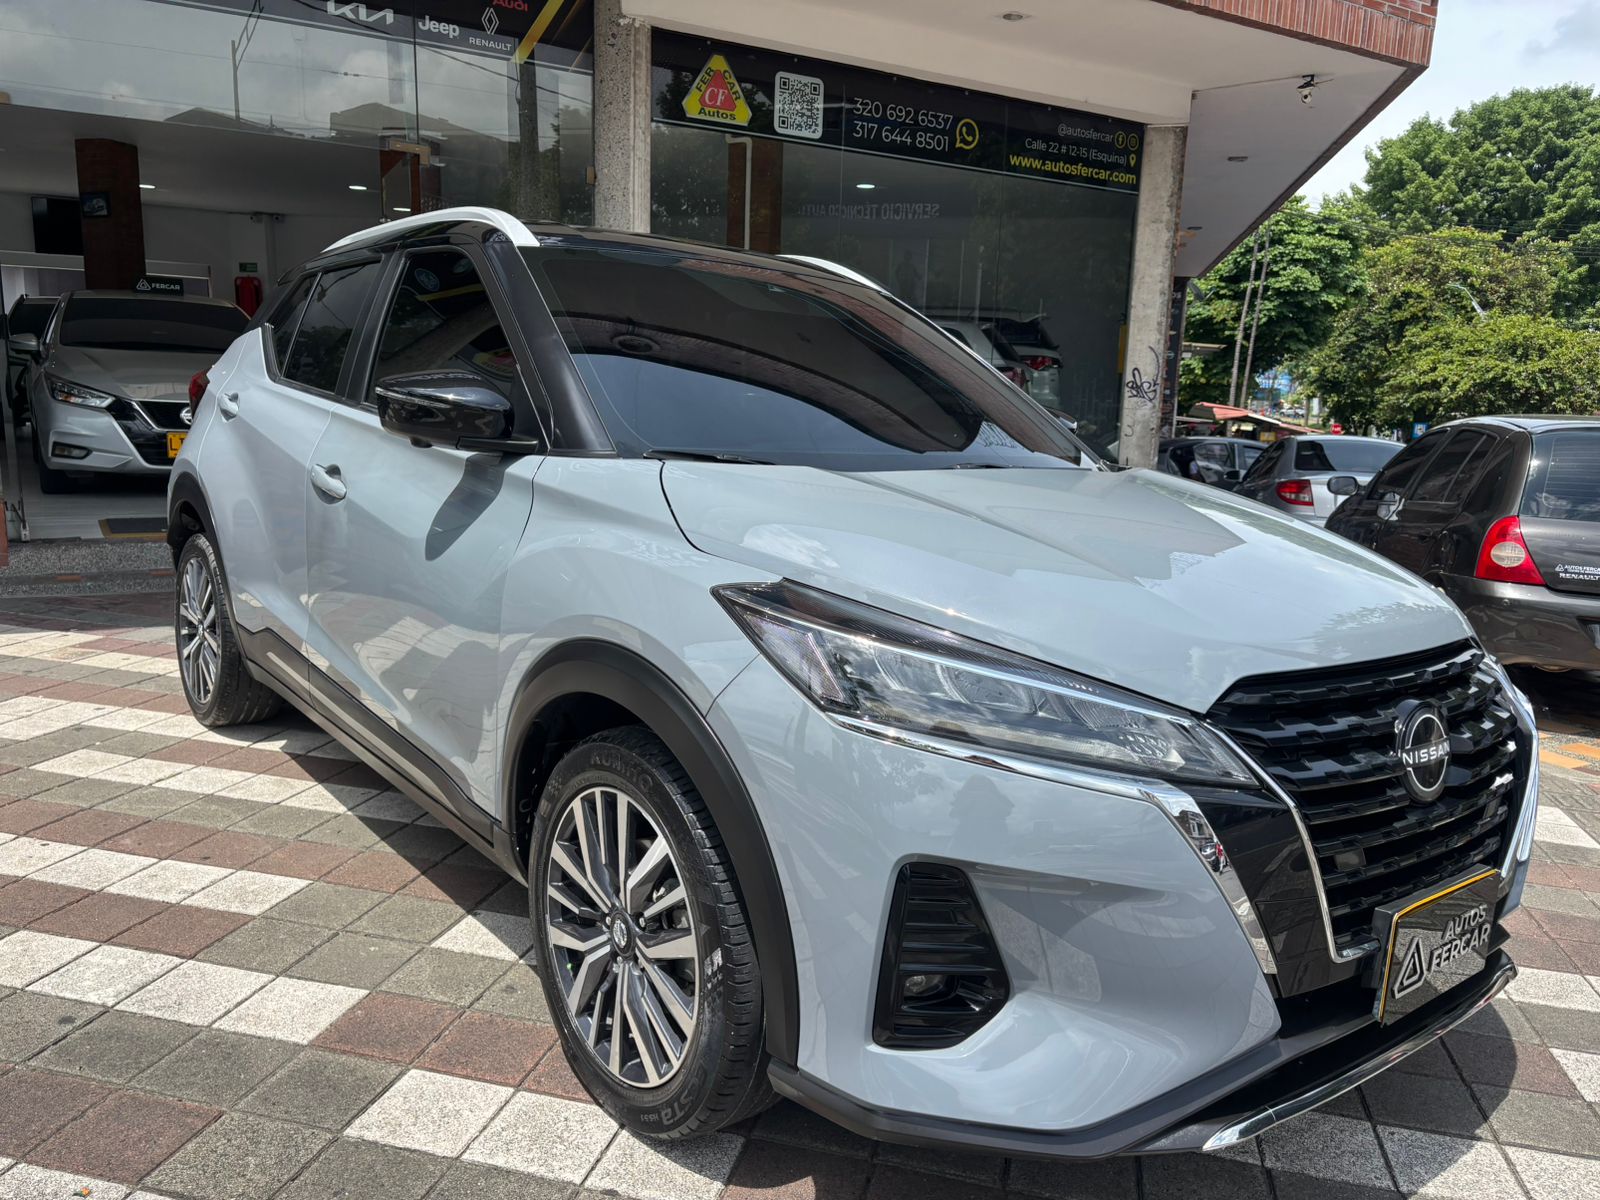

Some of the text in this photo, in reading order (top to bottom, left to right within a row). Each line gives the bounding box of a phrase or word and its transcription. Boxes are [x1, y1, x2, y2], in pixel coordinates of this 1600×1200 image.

[418, 15, 460, 39] Jeep
[469, 37, 512, 52] RENAULT
[695, 66, 715, 92] FER
[722, 69, 741, 101] CAR
[698, 107, 737, 121] Autos
[853, 97, 954, 131] 320 692 6537
[853, 120, 950, 152] 317 644 8501
[1058, 123, 1114, 143] @autosfercar
[1025, 138, 1127, 167] Calle 22 # 12-15 (Esquina)
[1009, 154, 1137, 185] www.autosfercar.com
[151, 282, 181, 291] FERCAR
[1559, 573, 1599, 581] RENAULT
[1402, 740, 1450, 765] NISSAN
[1441, 904, 1488, 942] AUTOS
[1429, 924, 1490, 974] FERCAR
